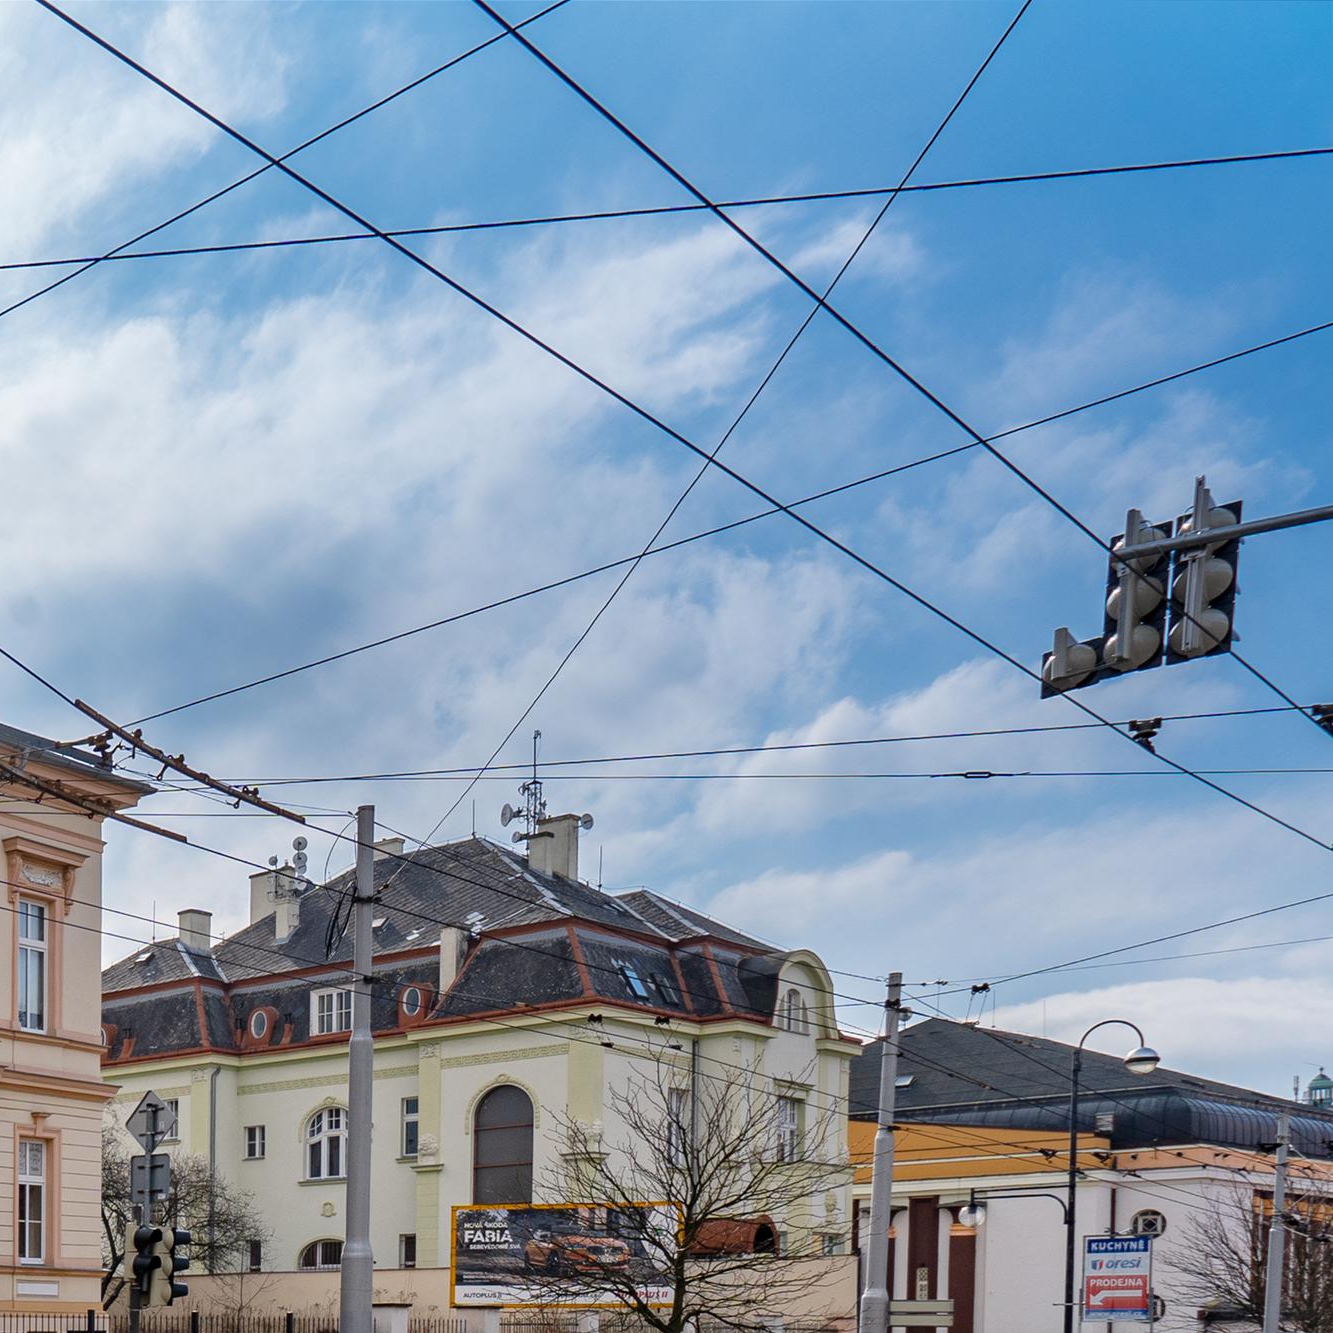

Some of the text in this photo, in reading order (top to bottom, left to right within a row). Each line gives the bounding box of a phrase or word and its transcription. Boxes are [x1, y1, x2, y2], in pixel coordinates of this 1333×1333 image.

[464, 1229, 513, 1243] FABIA
[1091, 1240, 1145, 1251] KUCHYNĚ
[1105, 1256, 1141, 1269] oresi
[1090, 1278, 1143, 1287] PRODEJNA
